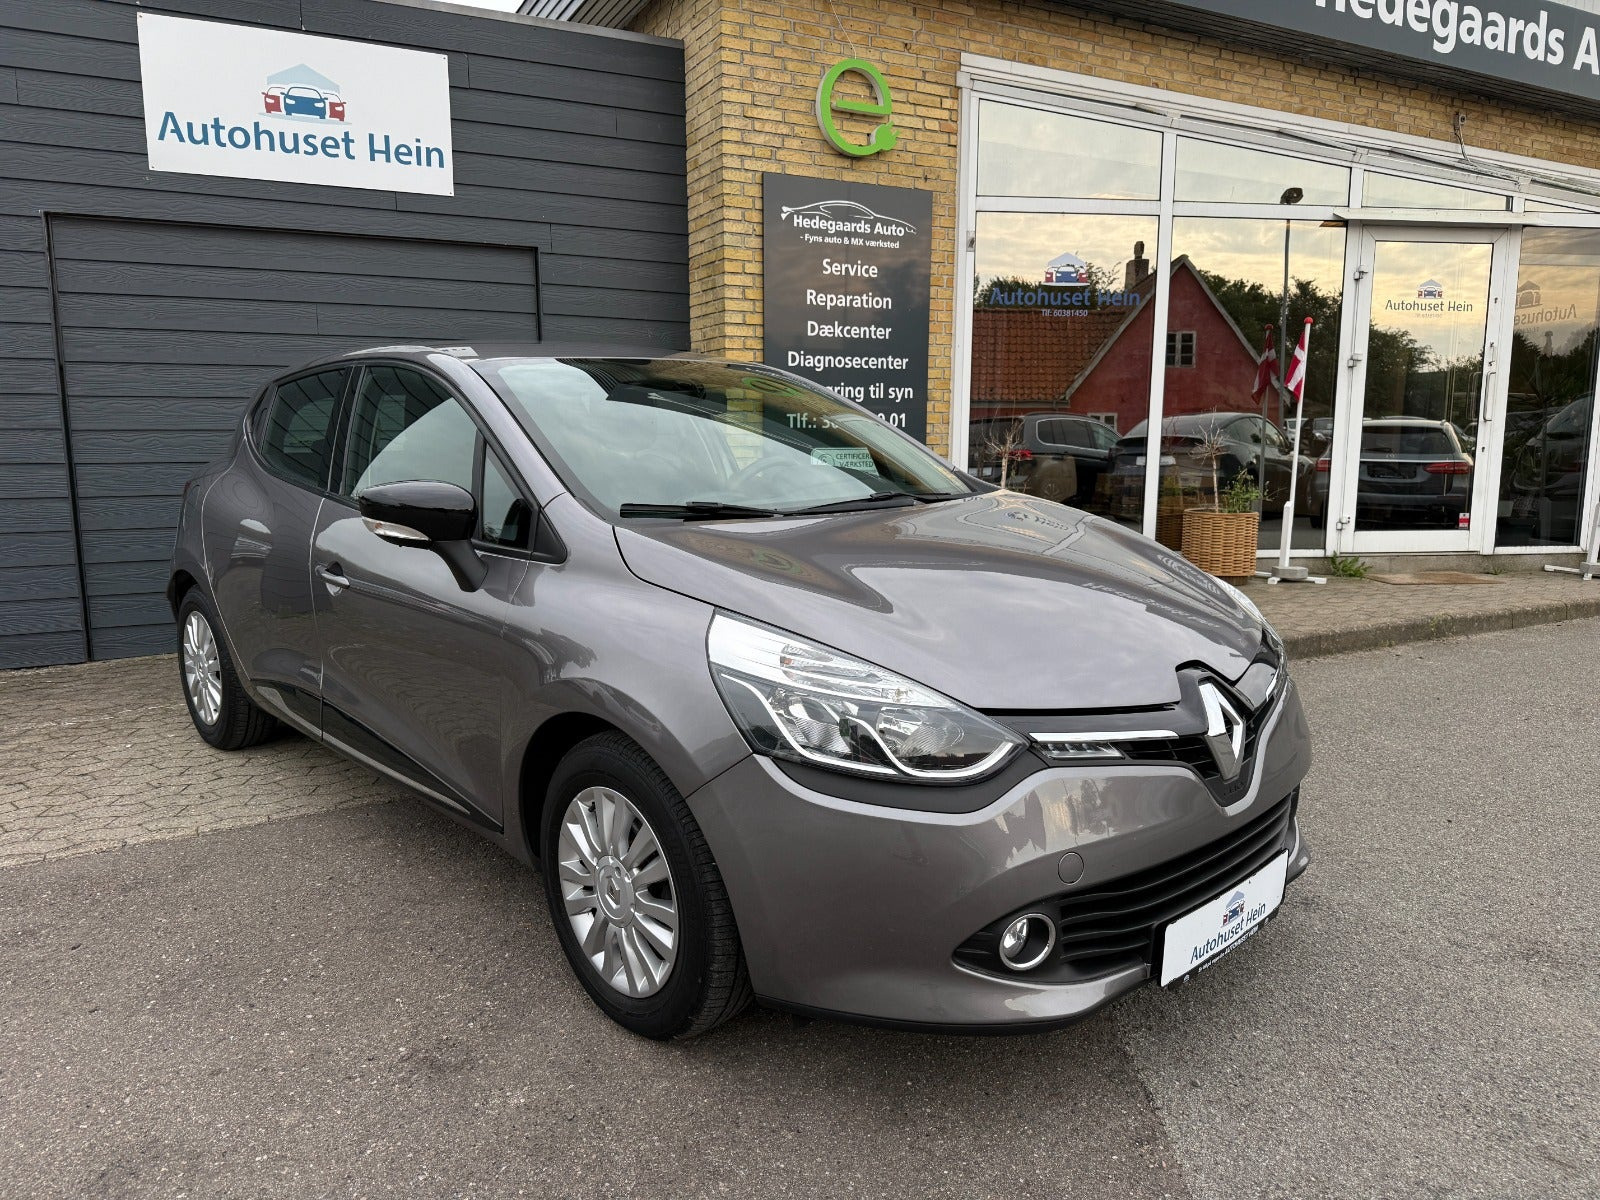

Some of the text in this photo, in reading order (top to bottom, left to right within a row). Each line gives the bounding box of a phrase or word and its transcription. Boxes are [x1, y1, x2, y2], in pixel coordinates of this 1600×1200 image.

[1315, 0, 1565, 65] edegaards
[157, 111, 445, 168] Autohuset Hein
[793, 214, 905, 236] Hedegaards Auto
[804, 234, 823, 243] Fyns
[824, 236, 842, 244] auto
[851, 237, 864, 246] MX
[865, 239, 900, 249] værksted
[822, 258, 878, 278] Service
[806, 289, 892, 310] Reparation
[990, 287, 1141, 306] Autohuset Hein
[1385, 299, 1473, 312] Autohuset Hein
[807, 321, 892, 339] Dækcenter
[787, 350, 909, 371] Diagnosecenter
[868, 383, 884, 399] til
[888, 387, 914, 402] syn
[786, 412, 817, 429] Tlf.:
[1190, 916, 1245, 964] Autohuset
[1245, 902, 1266, 927] Hein
